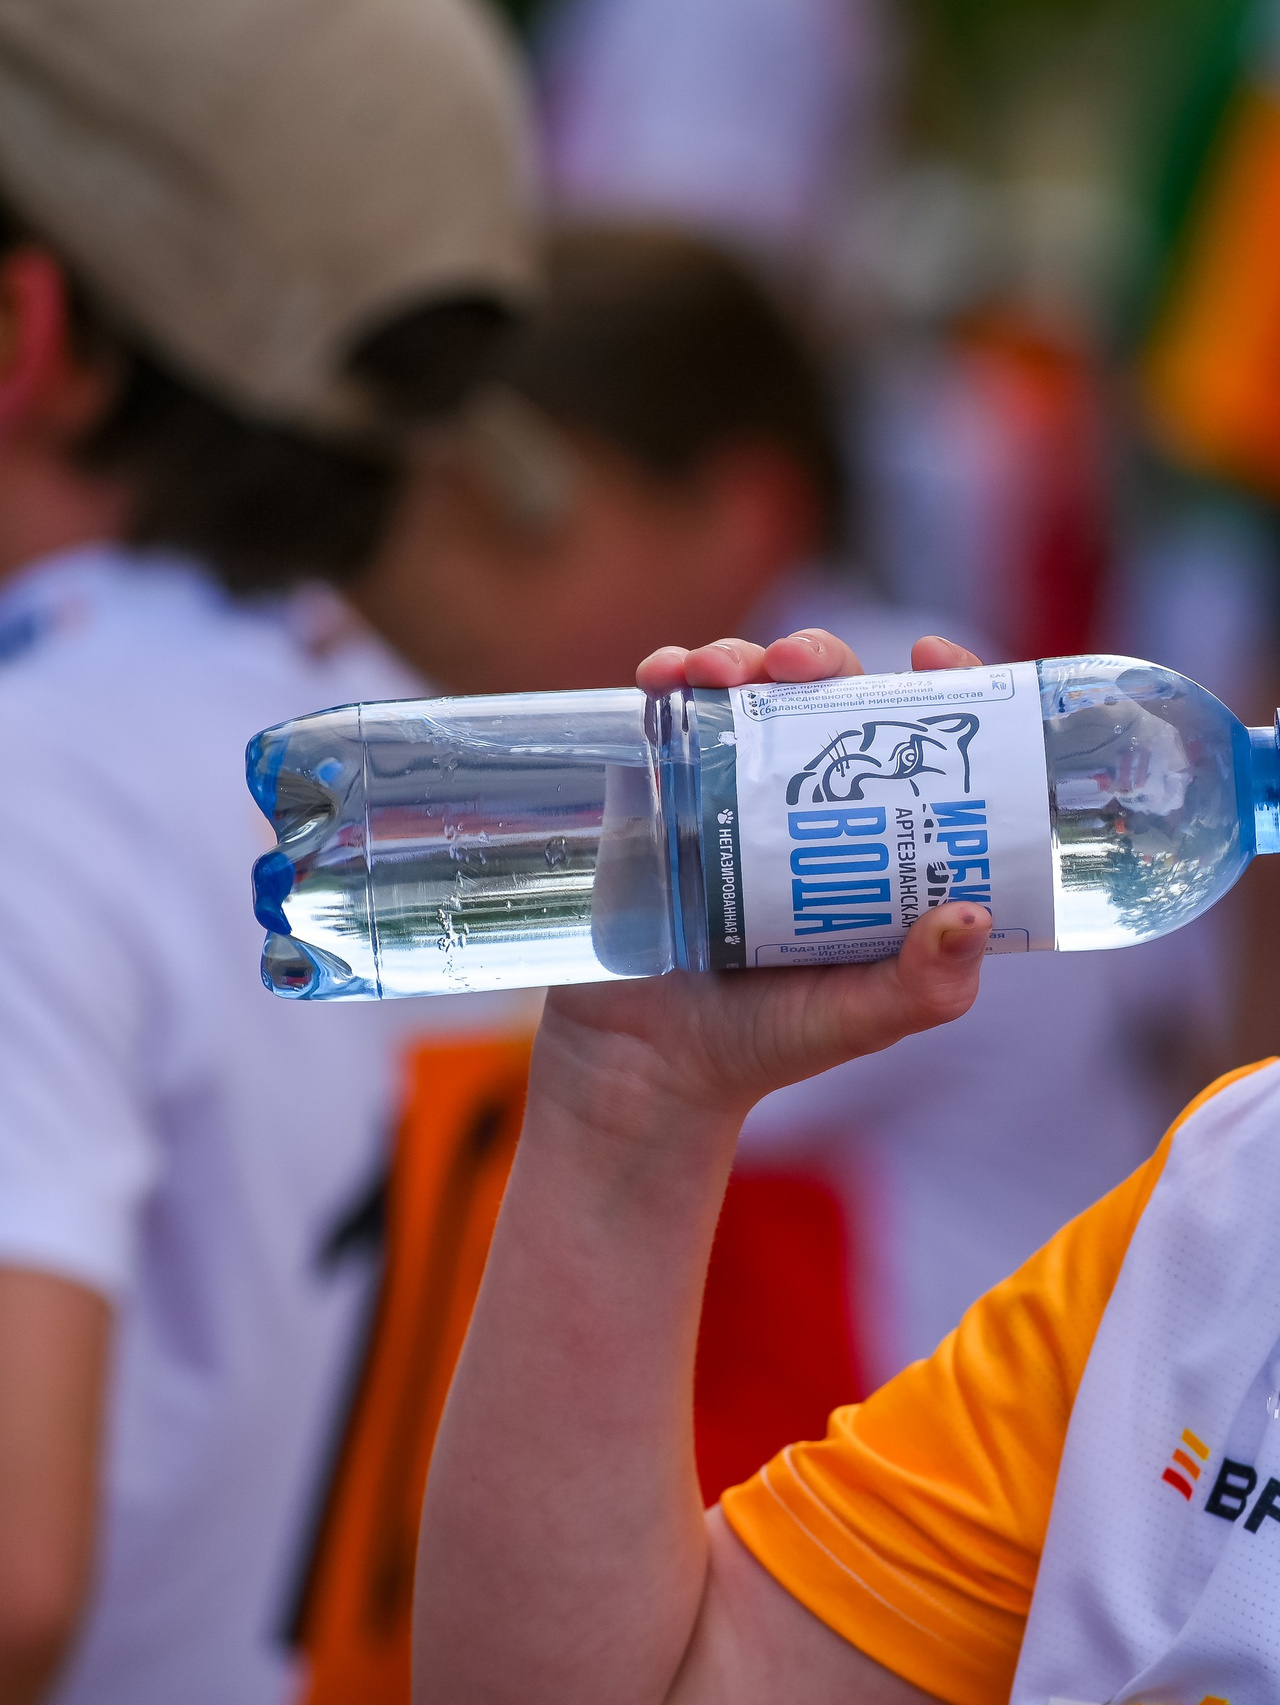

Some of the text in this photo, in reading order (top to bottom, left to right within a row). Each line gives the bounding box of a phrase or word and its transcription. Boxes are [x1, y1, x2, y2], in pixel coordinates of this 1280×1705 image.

[758, 687, 934, 708] Для ежедневного употребления
[759, 691, 984, 716] Сбалансированный минеральный состав
[718, 828, 738, 934] НЕГАЗИРОВАННАЯ
[787, 806, 893, 936] ВОДА
[929, 799, 992, 918] ИРБИ
[780, 945, 815, 953] Вода
[817, 940, 884, 951] питьевая
